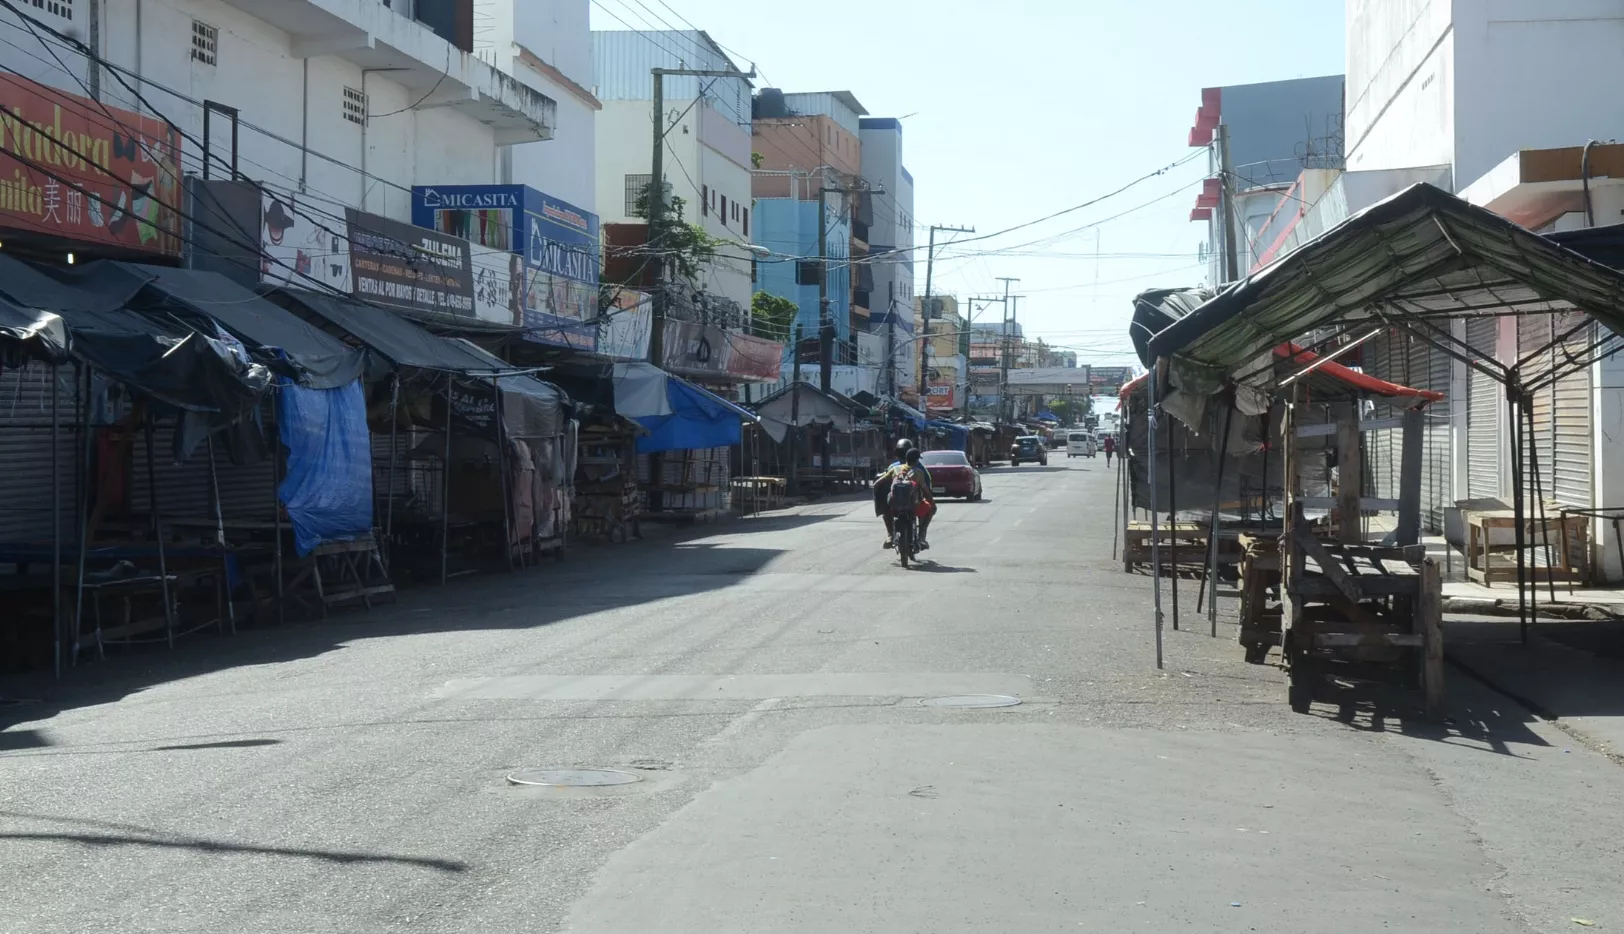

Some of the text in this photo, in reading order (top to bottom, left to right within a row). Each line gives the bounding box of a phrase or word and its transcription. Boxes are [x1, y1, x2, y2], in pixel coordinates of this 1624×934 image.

[442, 193, 518, 206] MICASITA
[542, 236, 595, 284] MICASITA
[358, 276, 379, 295] VENTAS
[378, 280, 385, 297] AL
[385, 281, 396, 298] POR
